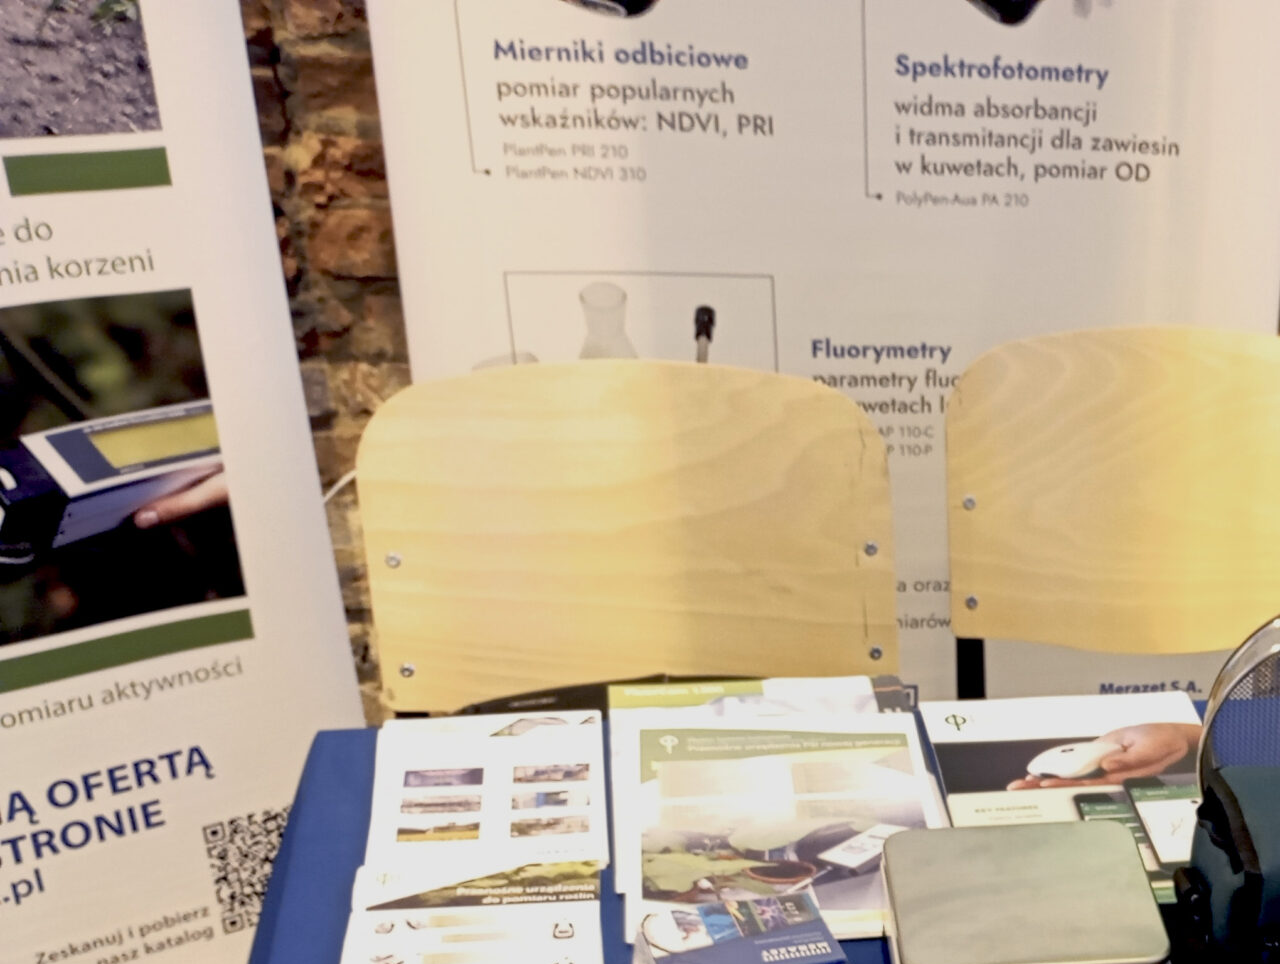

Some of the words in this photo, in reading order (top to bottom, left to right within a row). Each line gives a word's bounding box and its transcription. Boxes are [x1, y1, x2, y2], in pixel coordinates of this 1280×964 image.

[494, 39, 604, 63] Mierniki
[614, 41, 749, 70] odbiciowe
[895, 53, 1109, 90] Spektrofotometry
[496, 77, 580, 103] pomiar
[590, 78, 735, 107] popularnych
[499, 106, 648, 131] wskaźników:
[656, 111, 728, 137] NDVI,
[736, 114, 775, 136] PRI
[894, 95, 966, 118] widma
[973, 96, 1099, 126] absorbancji
[601, 144, 629, 159] 210
[895, 125, 901, 146] i
[908, 127, 1044, 154] transmitancji
[1050, 129, 1083, 151] dla
[1090, 134, 1181, 156] zawiesin
[573, 165, 614, 181] NDVI
[619, 166, 648, 182] 310
[895, 160, 912, 176] w
[920, 154, 1026, 181] kuwetach,
[1033, 160, 1108, 184] pomiar
[1114, 160, 1152, 182] OD
[1003, 192, 1030, 208] 210
[13, 216, 54, 244] do
[46, 248, 156, 281] korzeni
[811, 337, 952, 365] Fluorymetry
[855, 395, 932, 415] wetach
[0, 692, 96, 730] omiaru
[100, 656, 245, 706] aktywności
[1099, 681, 1167, 695] Merazet
[0, 789, 40, 828] Ą
[46, 744, 216, 811] OFERTĄ
[0, 799, 167, 869] TRONIE
[138, 905, 212, 938] pobierz
[144, 925, 216, 957] katalog
